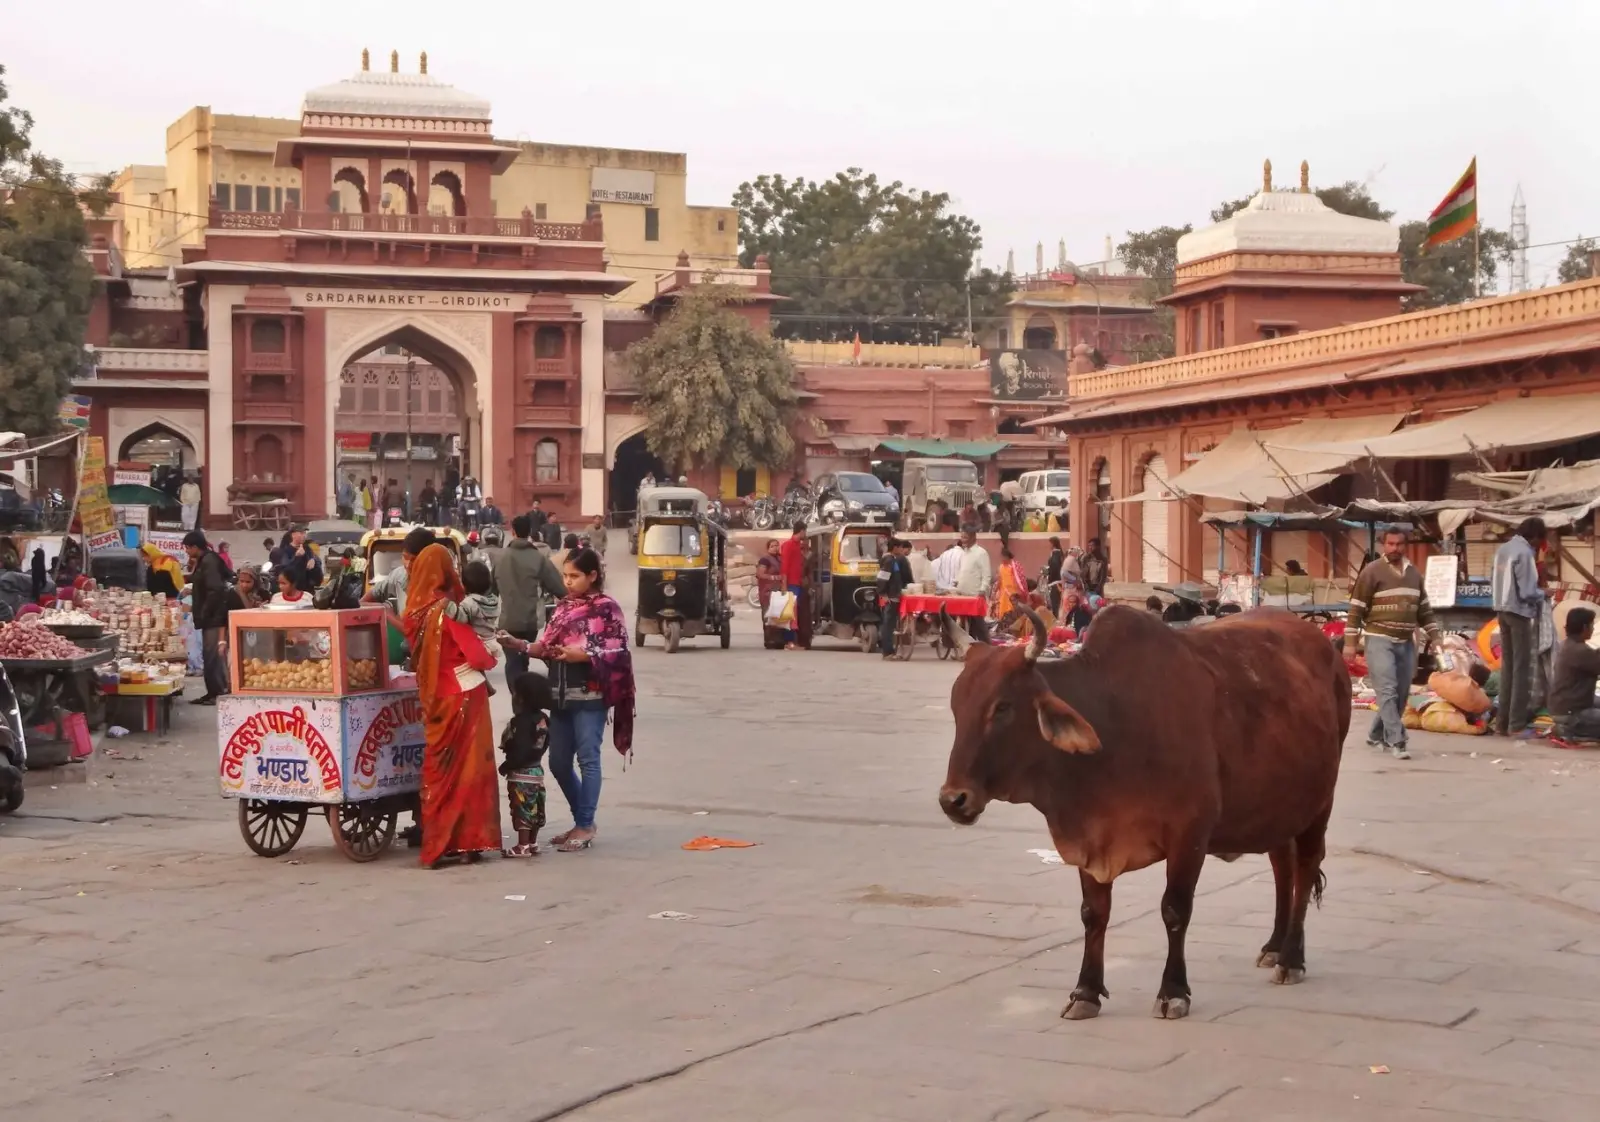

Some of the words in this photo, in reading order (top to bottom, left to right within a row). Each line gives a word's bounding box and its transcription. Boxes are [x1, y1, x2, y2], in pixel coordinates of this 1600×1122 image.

[615, 190, 653, 202] RESTAURANT
[158, 540, 185, 551] FOREX
[256, 756, 309, 783] भण्डार
